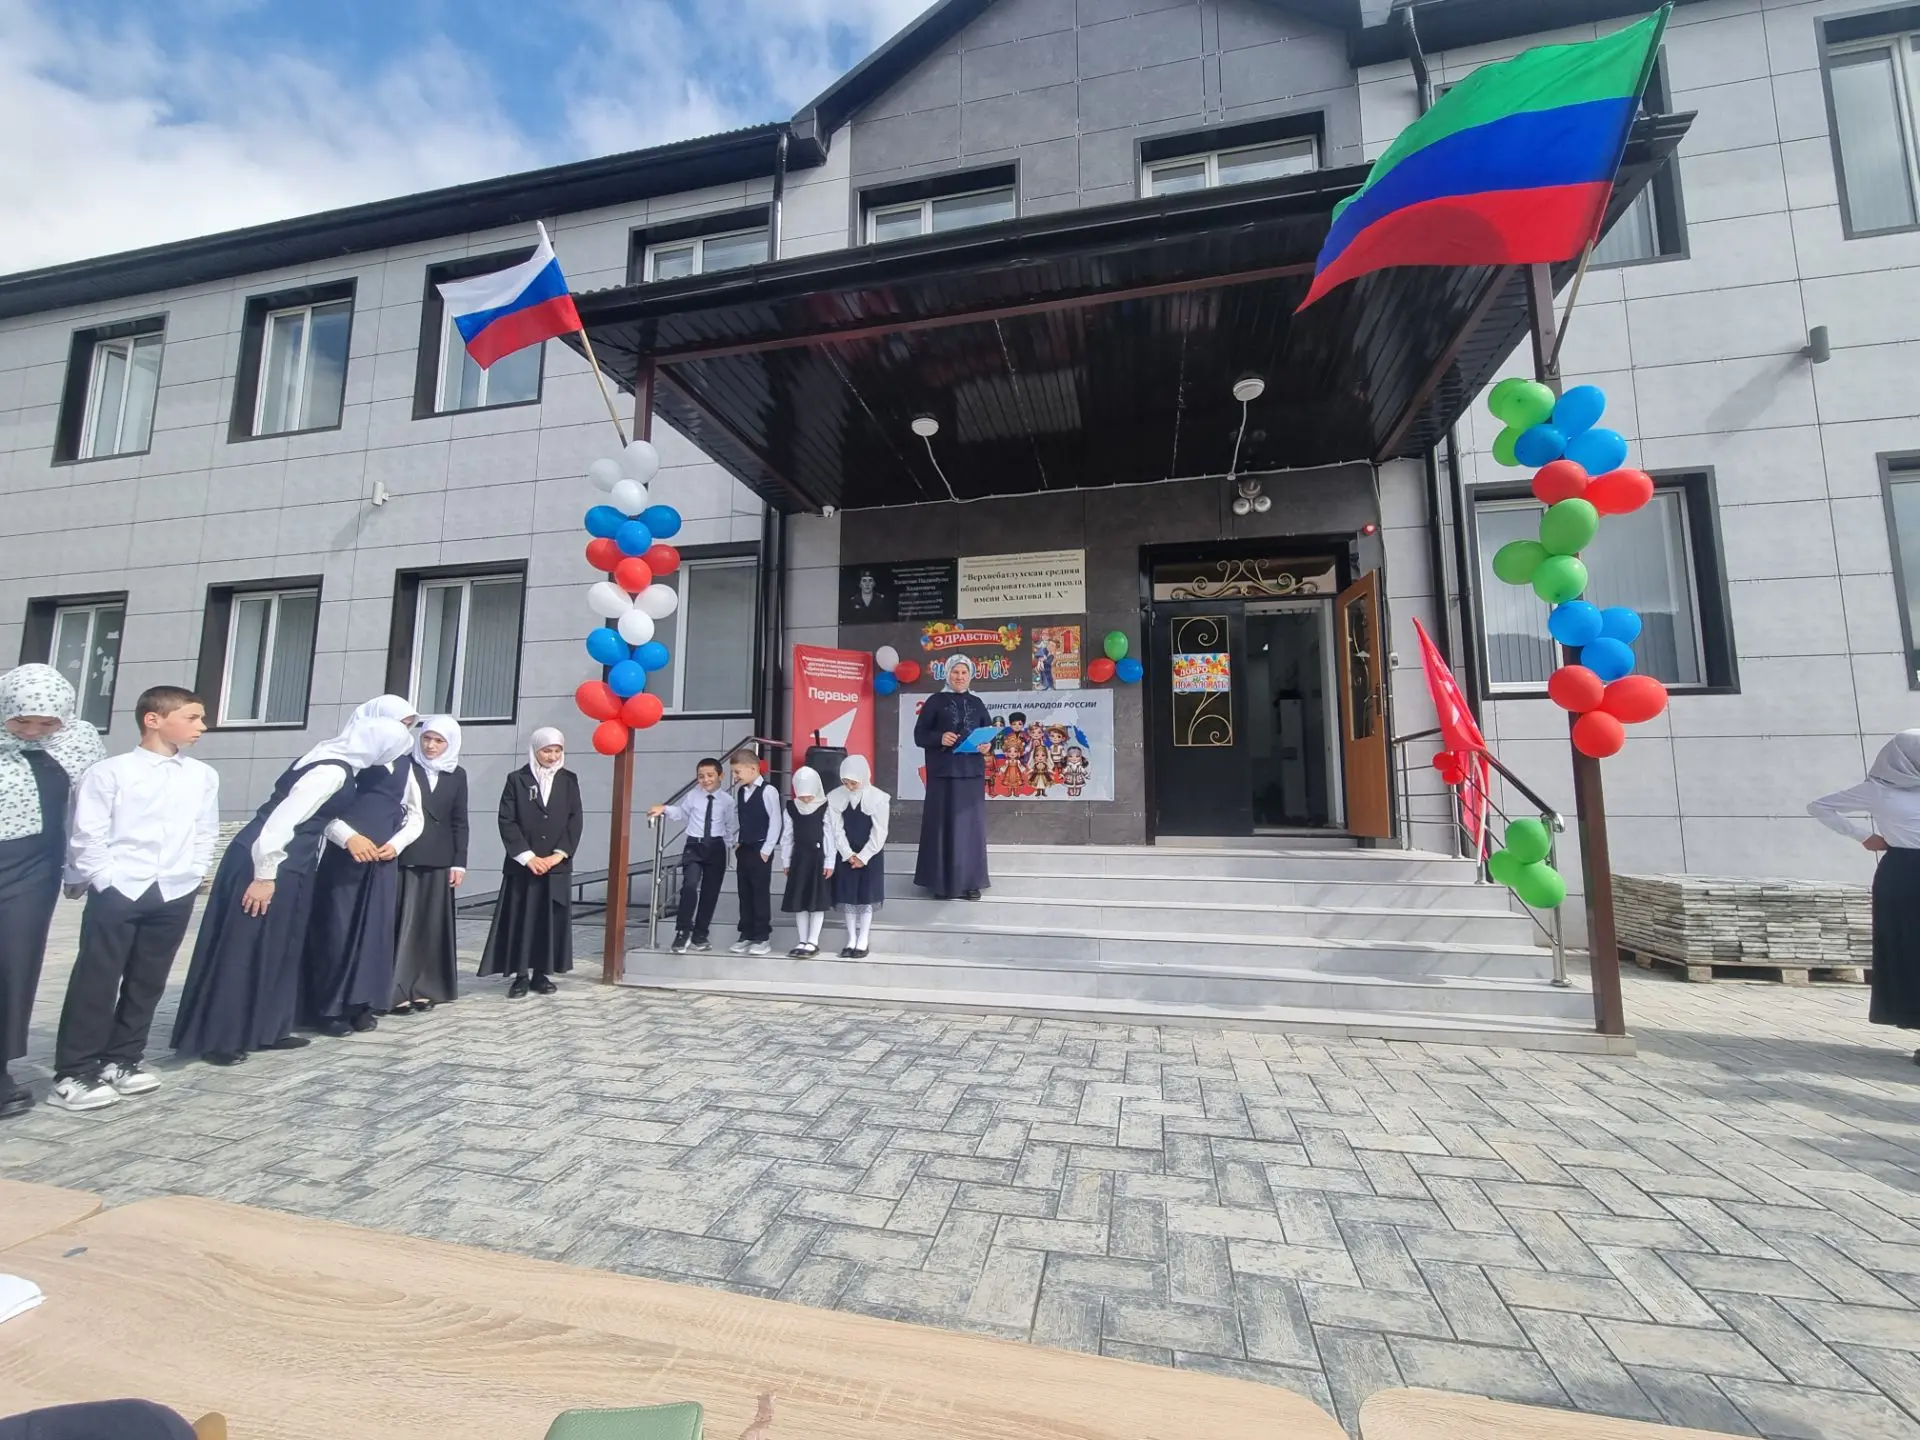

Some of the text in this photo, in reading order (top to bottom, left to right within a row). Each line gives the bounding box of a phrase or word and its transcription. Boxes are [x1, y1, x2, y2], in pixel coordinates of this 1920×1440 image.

[1060, 630, 1072, 654] 1
[1180, 666, 1209, 677] ДОБРО
[808, 686, 859, 704] Первые
[984, 701, 1097, 711] ДИНСТВА НАРОДОВ РОССИИ
